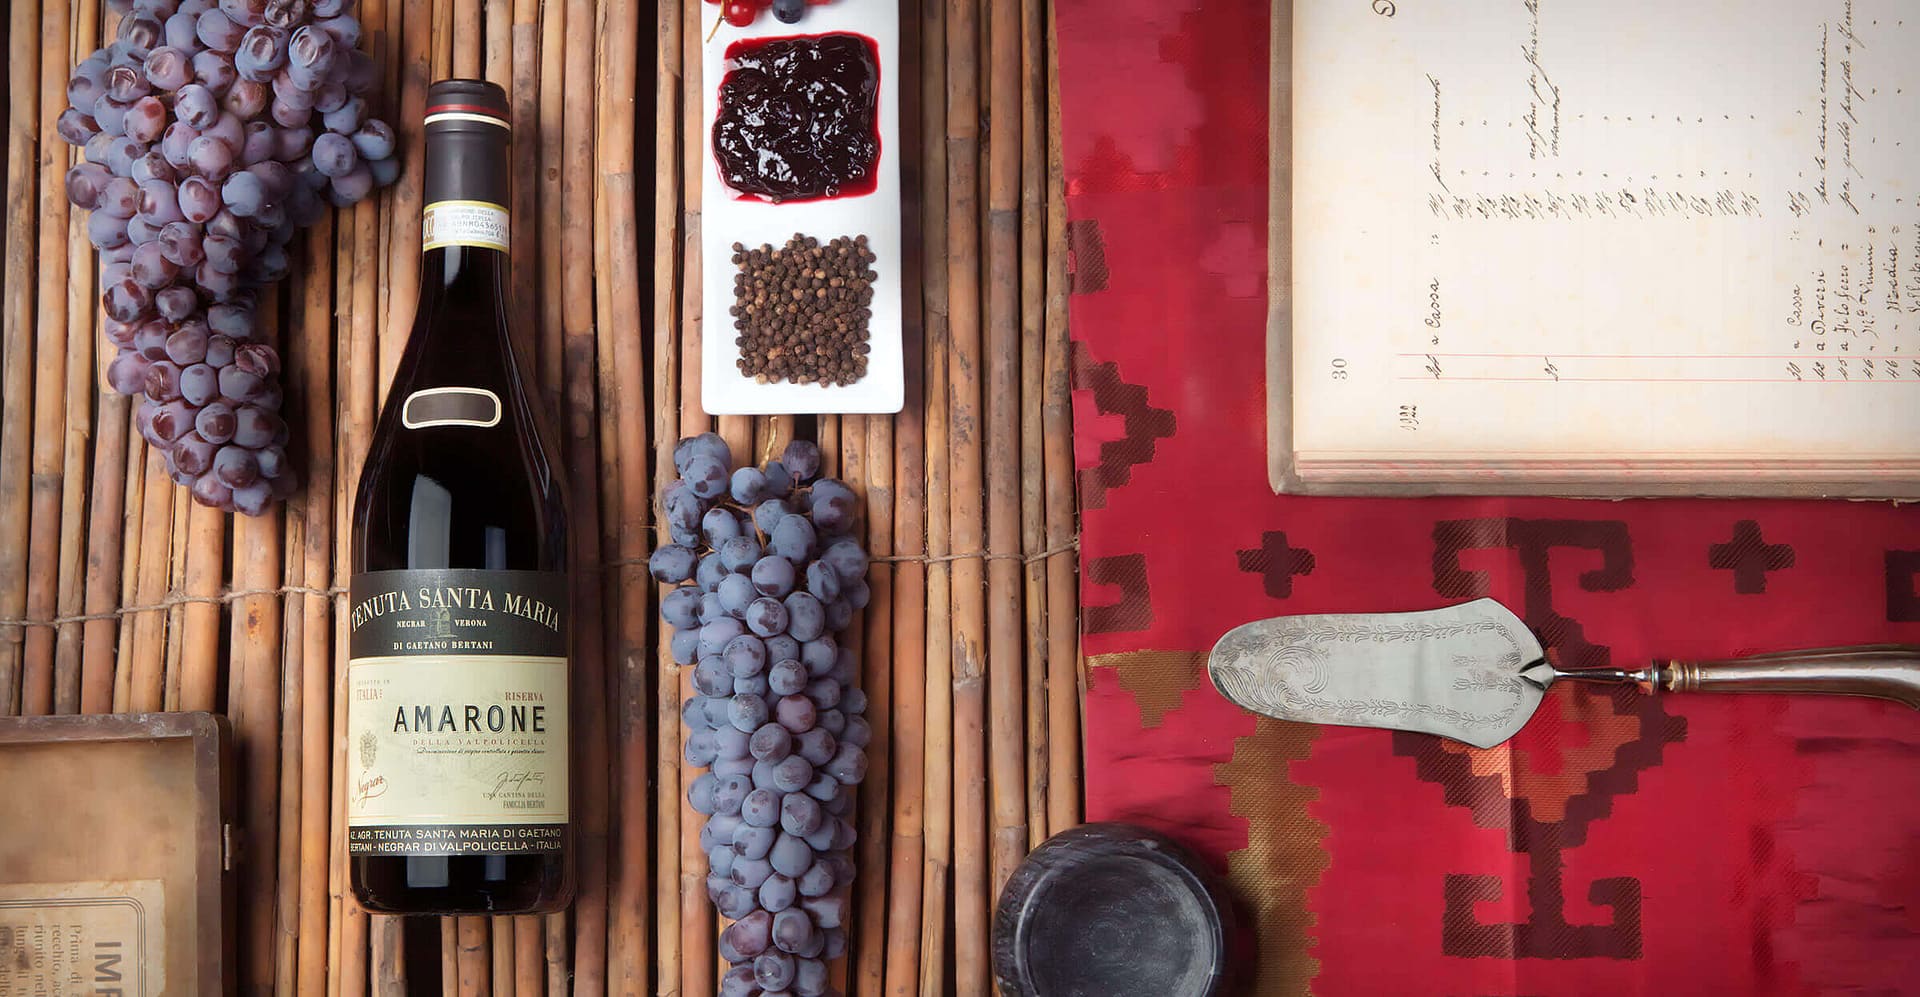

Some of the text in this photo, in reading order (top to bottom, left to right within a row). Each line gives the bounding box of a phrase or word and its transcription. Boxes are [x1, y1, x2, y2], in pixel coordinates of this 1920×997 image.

[1425, 278, 1440, 329] Cassa
[1786, 285, 1802, 327] Cassa
[1810, 270, 1826, 336] Diversi
[1816, 342, 1826, 351] a
[1839, 341, 1849, 352] a
[1331, 358, 1347, 380] 30
[1399, 404, 1419, 431] 1922
[351, 587, 559, 633] TENUTA SANTA MARIA
[396, 619, 487, 628] NEGRAR VERONA
[393, 641, 493, 650] DI GAETANO BERTANI
[505, 692, 544, 701] RISERVA
[393, 705, 546, 733] AMARONE
[374, 830, 411, 839] TENUTA
[416, 830, 456, 839] SANTA
[460, 829, 500, 838] MARIA
[503, 829, 514, 838] DI
[518, 828, 561, 838] GAETANO
[378, 842, 420, 852] NEGRAR
[424, 842, 436, 851] DI
[438, 841, 528, 851] VALPOLICELLA
[536, 841, 562, 850] ITALIA
[34, 924, 47, 969] riunito
[70, 924, 83, 963] Prima
[70, 972, 83, 984] di
